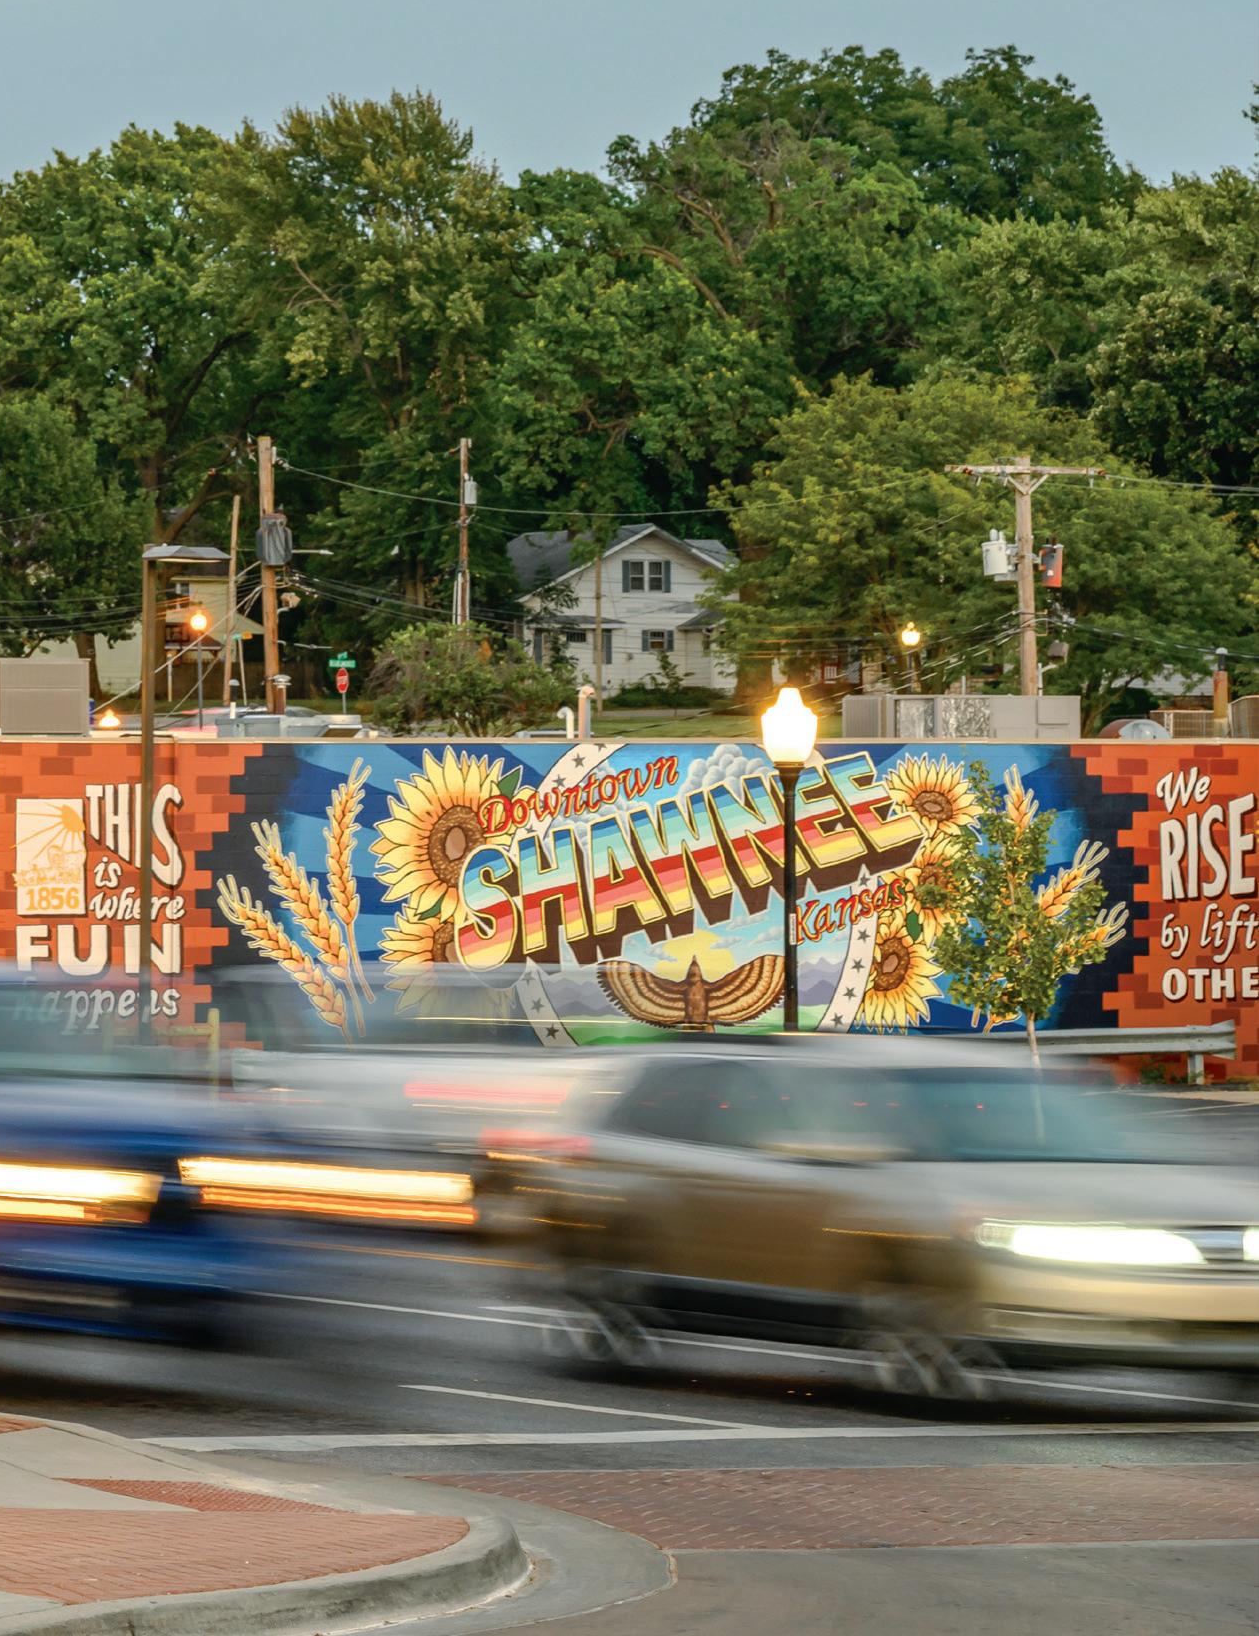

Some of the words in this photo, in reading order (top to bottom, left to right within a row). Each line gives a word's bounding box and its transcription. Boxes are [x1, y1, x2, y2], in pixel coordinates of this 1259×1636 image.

[477, 756, 679, 837] Downtown
[1156, 766, 1211, 813] We
[85, 783, 183, 887] THIS
[454, 750, 926, 972] SHAWNEE
[1160, 792, 1256, 901] RISE
[26, 887, 80, 911] 1856
[94, 856, 122, 888] is
[796, 878, 906, 945] Kansas
[1162, 913, 1190, 957] by
[15, 923, 181, 977] FUN
